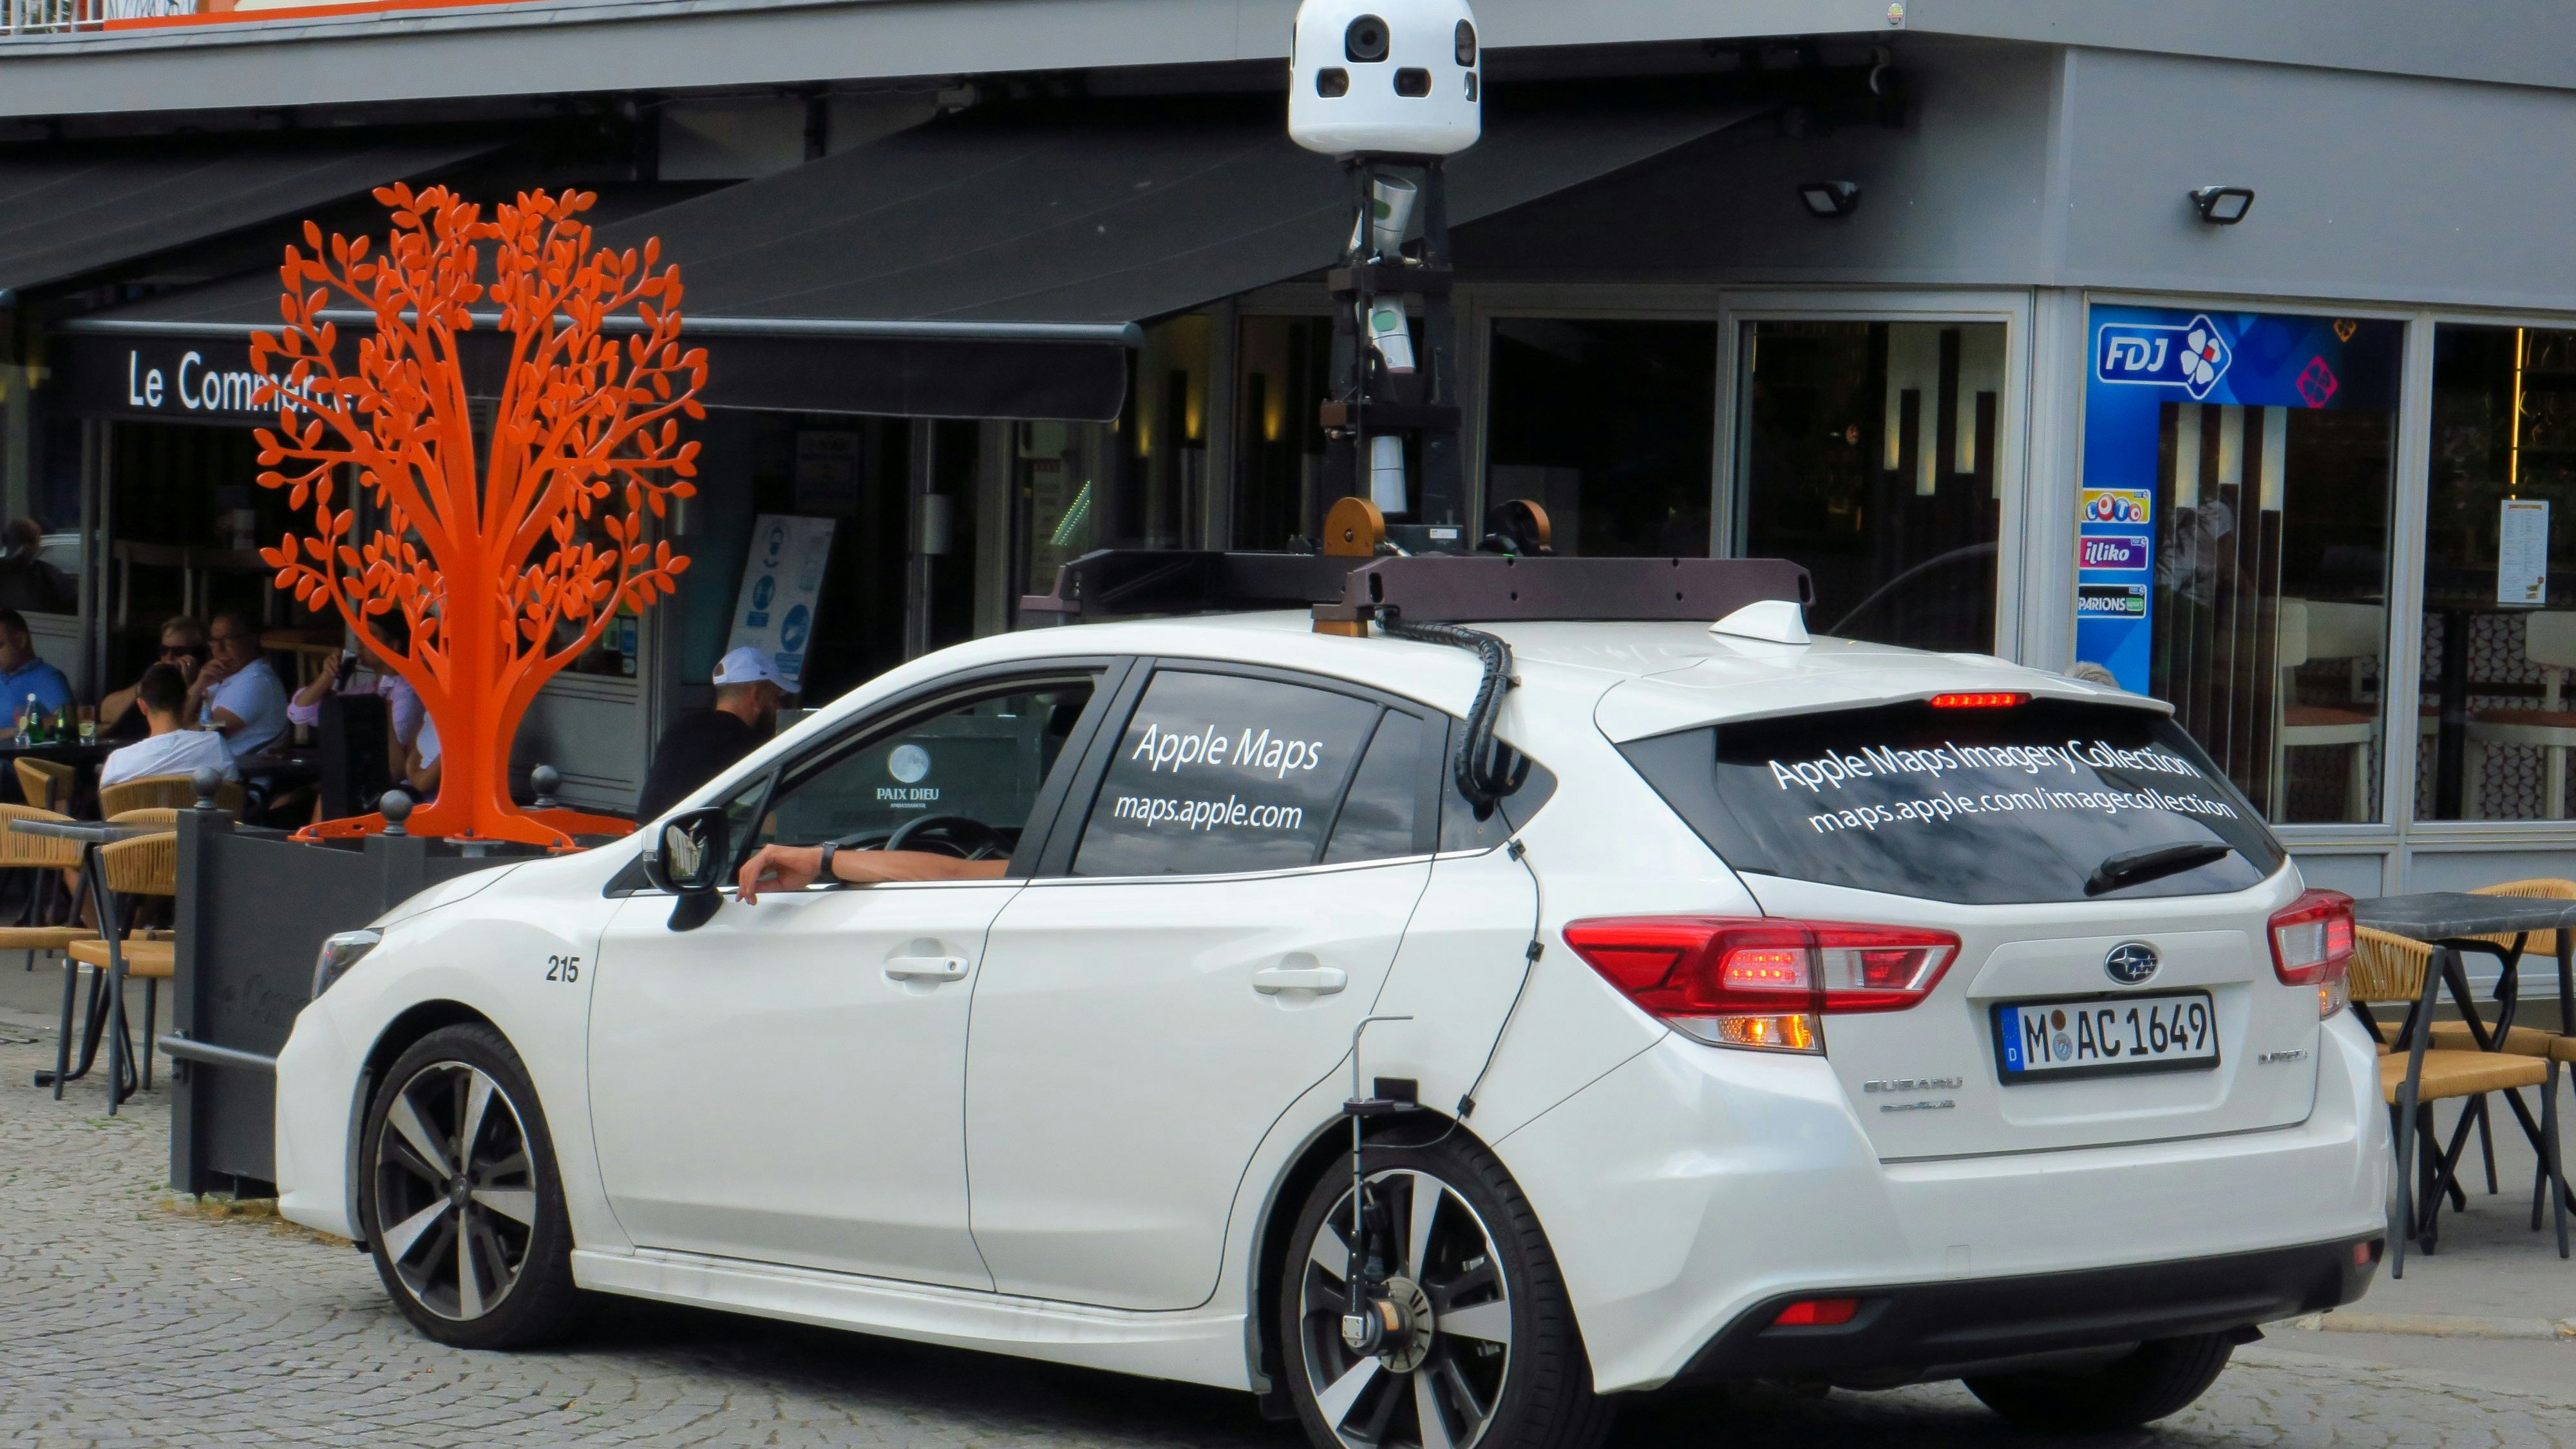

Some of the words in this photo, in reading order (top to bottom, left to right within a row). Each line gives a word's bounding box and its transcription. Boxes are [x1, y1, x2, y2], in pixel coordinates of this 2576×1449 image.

[2105, 336, 2168, 372] FDJ
[129, 350, 163, 408] Le
[178, 350, 354, 415] Commer
[2085, 493, 2142, 522] LOTO
[2085, 541, 2130, 565] illiko
[2078, 597, 2126, 611] PARIONS
[1132, 723, 1228, 773] Apple
[1231, 728, 1323, 779] Maps
[1768, 748, 1873, 793] Apple
[1861, 744, 1958, 779] Maps
[1944, 741, 2076, 775] Imagery
[2067, 739, 2201, 779] Collection
[876, 788, 908, 800] PAIX
[909, 788, 940, 800] DIEU
[1807, 787, 2239, 833] maps.apple.com/imagecollection
[1113, 795, 1303, 831] maps.apple.com
[545, 954, 581, 983] 215
[2008, 1047, 2018, 1062] D
[2023, 1014, 2050, 1064] M
